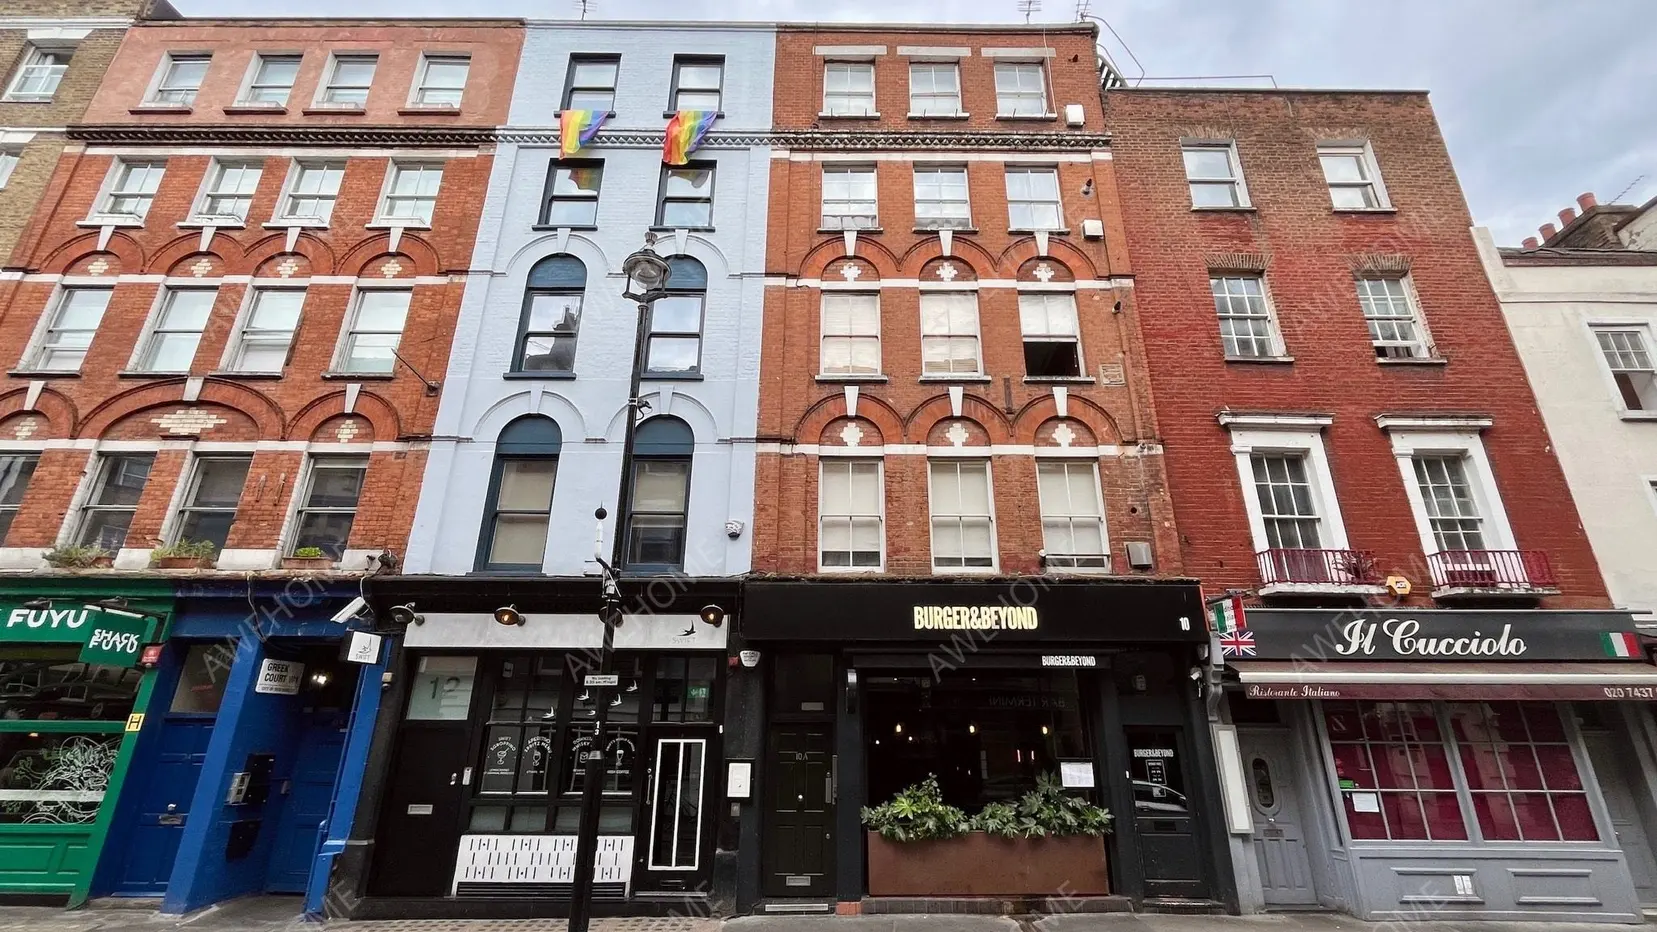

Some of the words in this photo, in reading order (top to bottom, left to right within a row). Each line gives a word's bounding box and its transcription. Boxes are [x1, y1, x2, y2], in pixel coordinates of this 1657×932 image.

[6, 609, 88, 628] FUYU
[914, 606, 1038, 630] BURGER&BEYOND
[1179, 617, 1190, 631] 10
[94, 629, 139, 643] SHACK
[1335, 619, 1377, 656] Il
[1382, 619, 1527, 656] Cucciolo
[89, 636, 138, 653] FUYU
[267, 662, 290, 672] GREEK
[1042, 655, 1096, 667] BURGER&BEYOND
[264, 672, 287, 683] COURT
[1249, 684, 1298, 698] Ristorante
[1301, 684, 1341, 697] Italiano
[1604, 687, 1625, 698] 020
[1626, 687, 1654, 698] 7437
[128, 715, 142, 730] H
